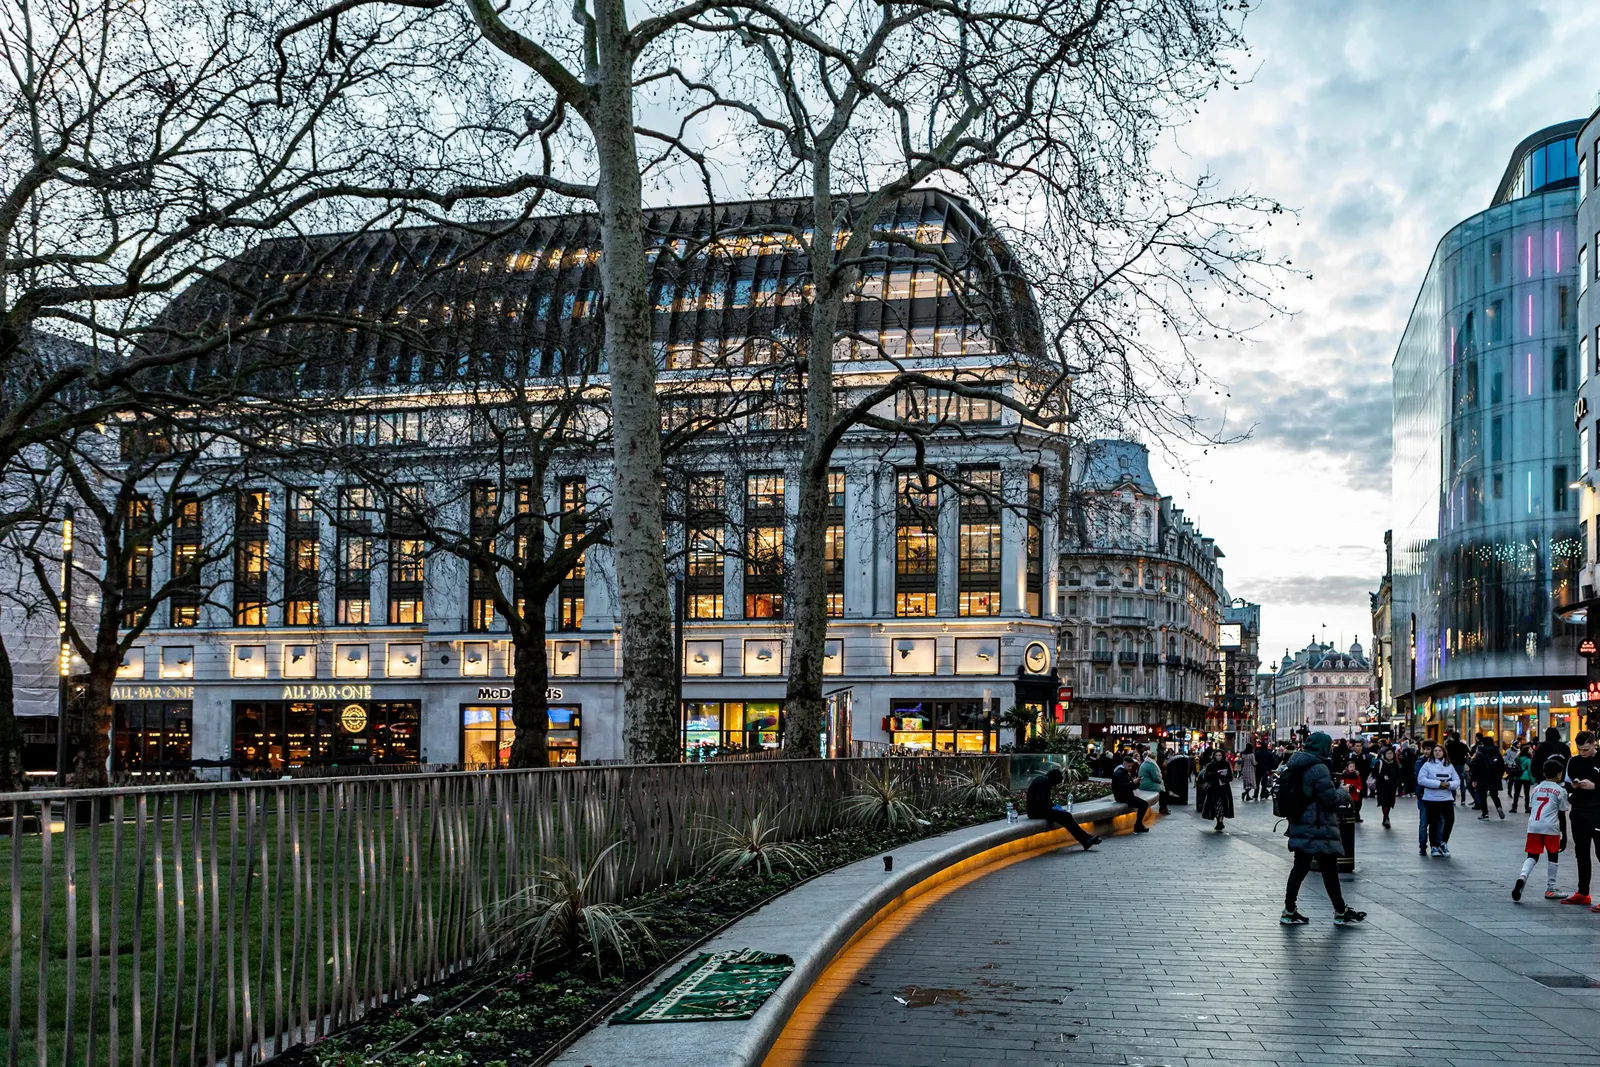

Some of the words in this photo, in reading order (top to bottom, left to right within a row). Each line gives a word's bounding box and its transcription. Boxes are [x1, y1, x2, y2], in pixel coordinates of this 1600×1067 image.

[1521, 695, 1551, 704] WALL
[1123, 725, 1128, 735] A
[1535, 797, 1550, 821] 7
